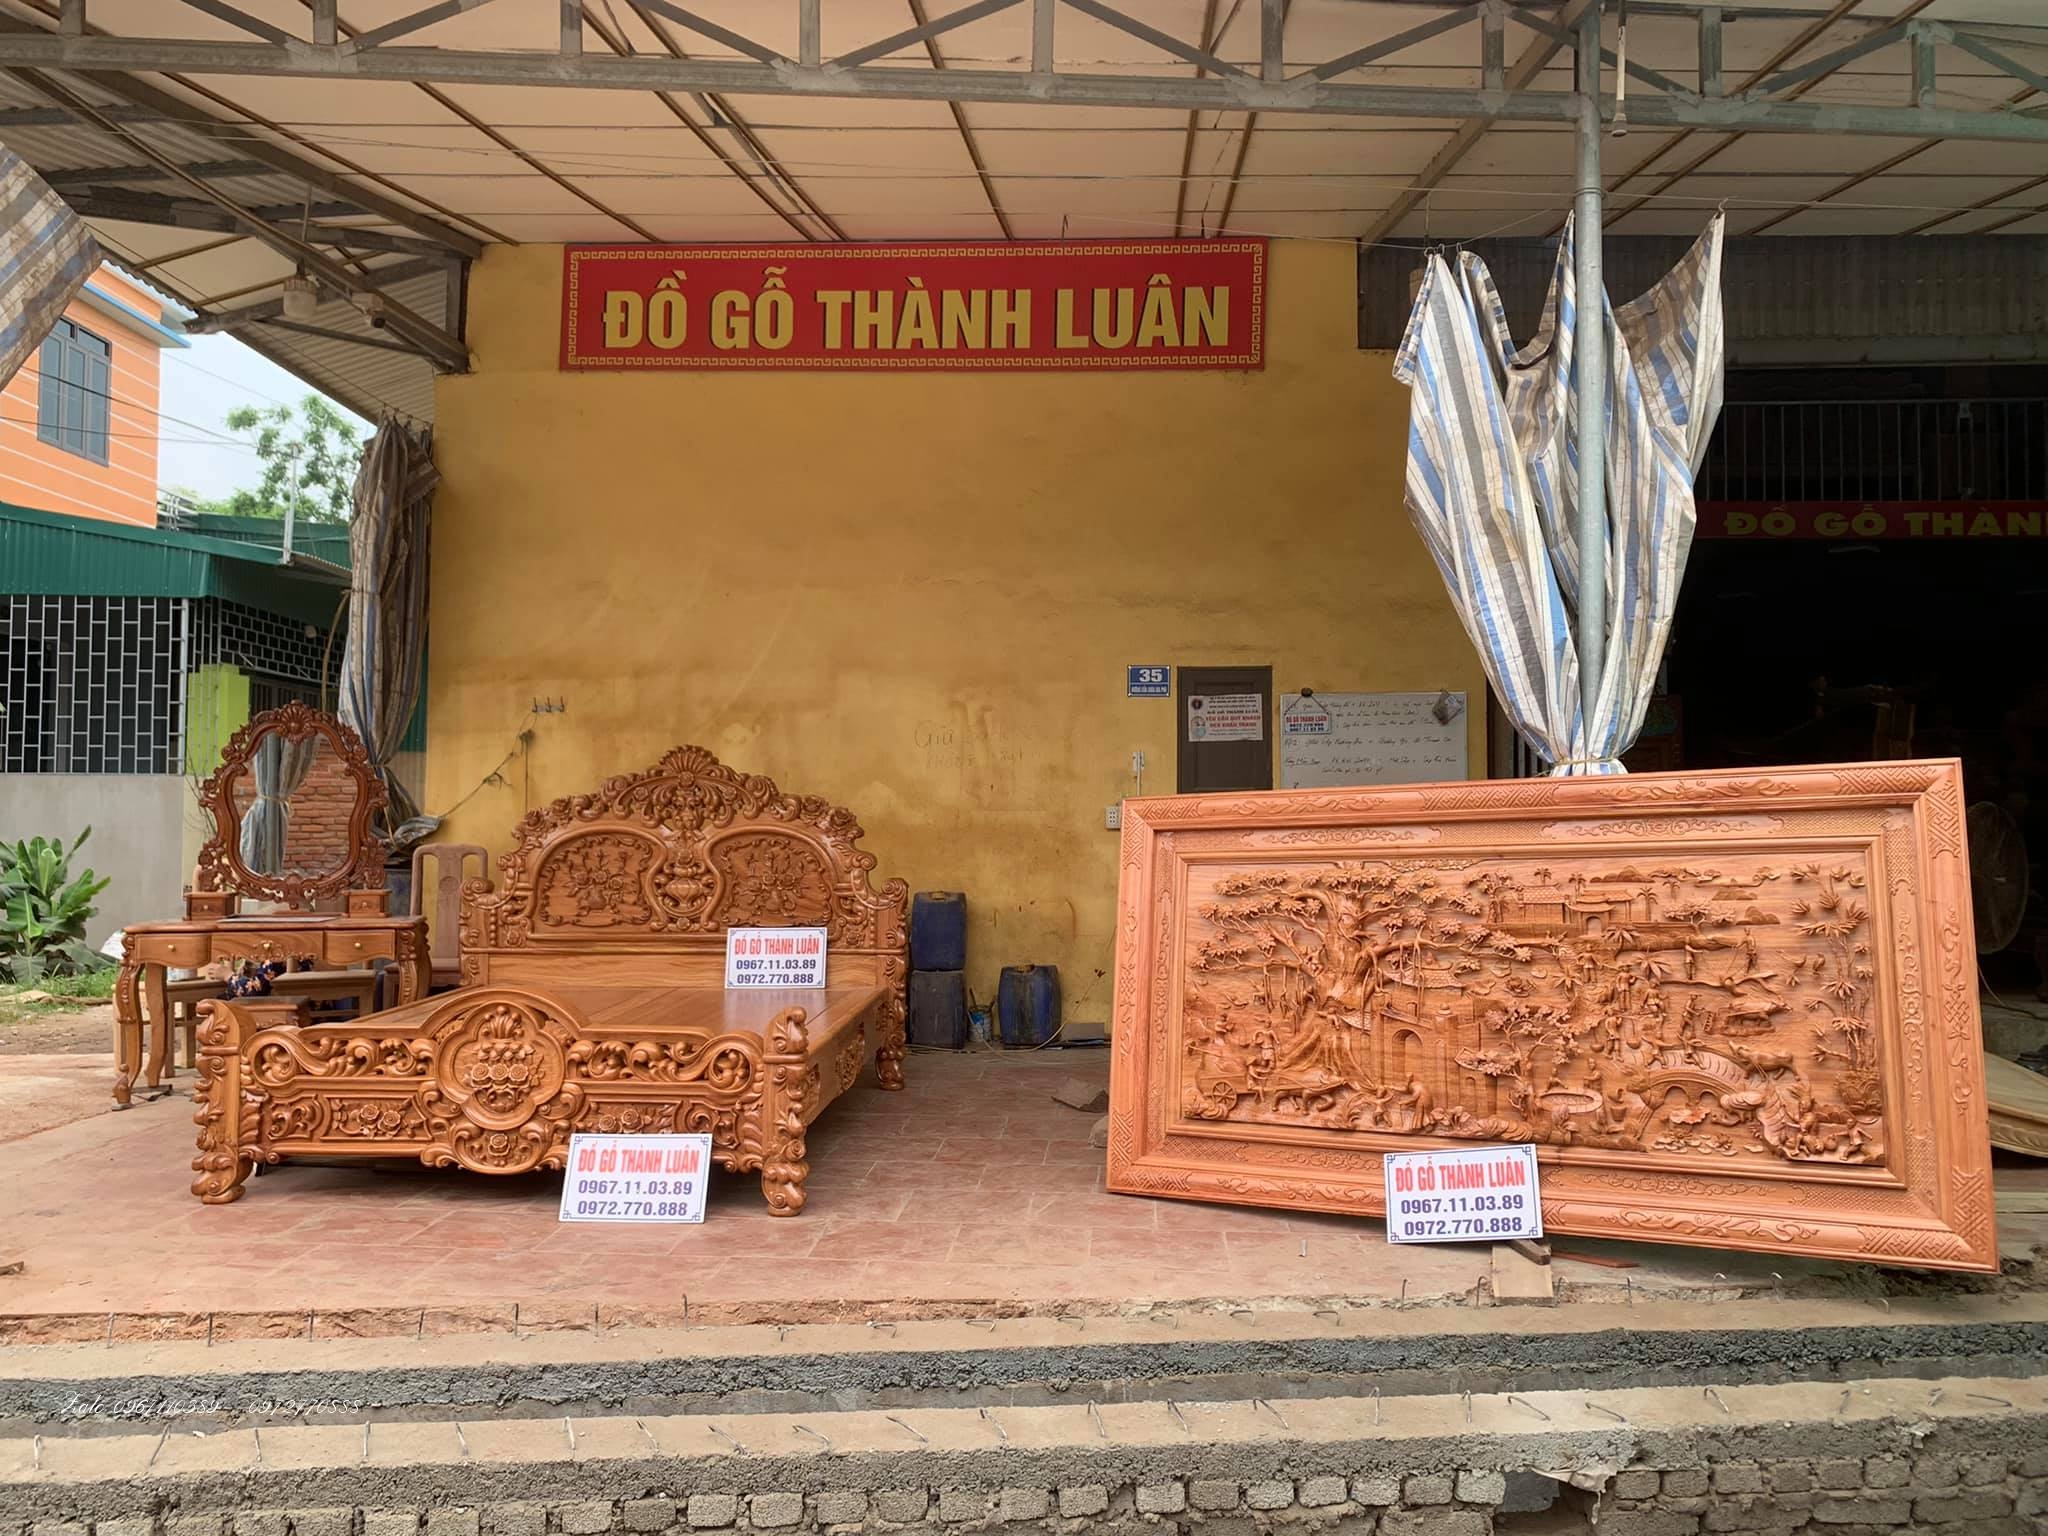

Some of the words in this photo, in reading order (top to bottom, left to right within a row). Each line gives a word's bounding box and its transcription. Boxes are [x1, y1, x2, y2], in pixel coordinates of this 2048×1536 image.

[602, 270, 687, 349] ĐỒ
[711, 267, 793, 349] GỖ
[816, 277, 1032, 349] THÀNH
[1055, 274, 1229, 348] LUÂN
[1904, 507, 2048, 536] THÀN
[1138, 668, 1163, 682] 35
[796, 934, 820, 955] LUÂN
[736, 959, 817, 970] 0967.11.03.89
[737, 973, 814, 984] 0972.770.888
[665, 1144, 701, 1174] LUÂN
[1395, 1158, 1413, 1192] ĐỒ
[1417, 1156, 1435, 1191] GỖ
[1439, 1158, 1485, 1190] THÀNH
[1488, 1155, 1526, 1188] LUÂN
[578, 1179, 693, 1195] 0967.11.03.89
[577, 1200, 688, 1217] 0972.770.888
[1400, 1194, 1524, 1214] 0967.11.03.89
[1404, 1216, 1523, 1236] 0972.770.888
